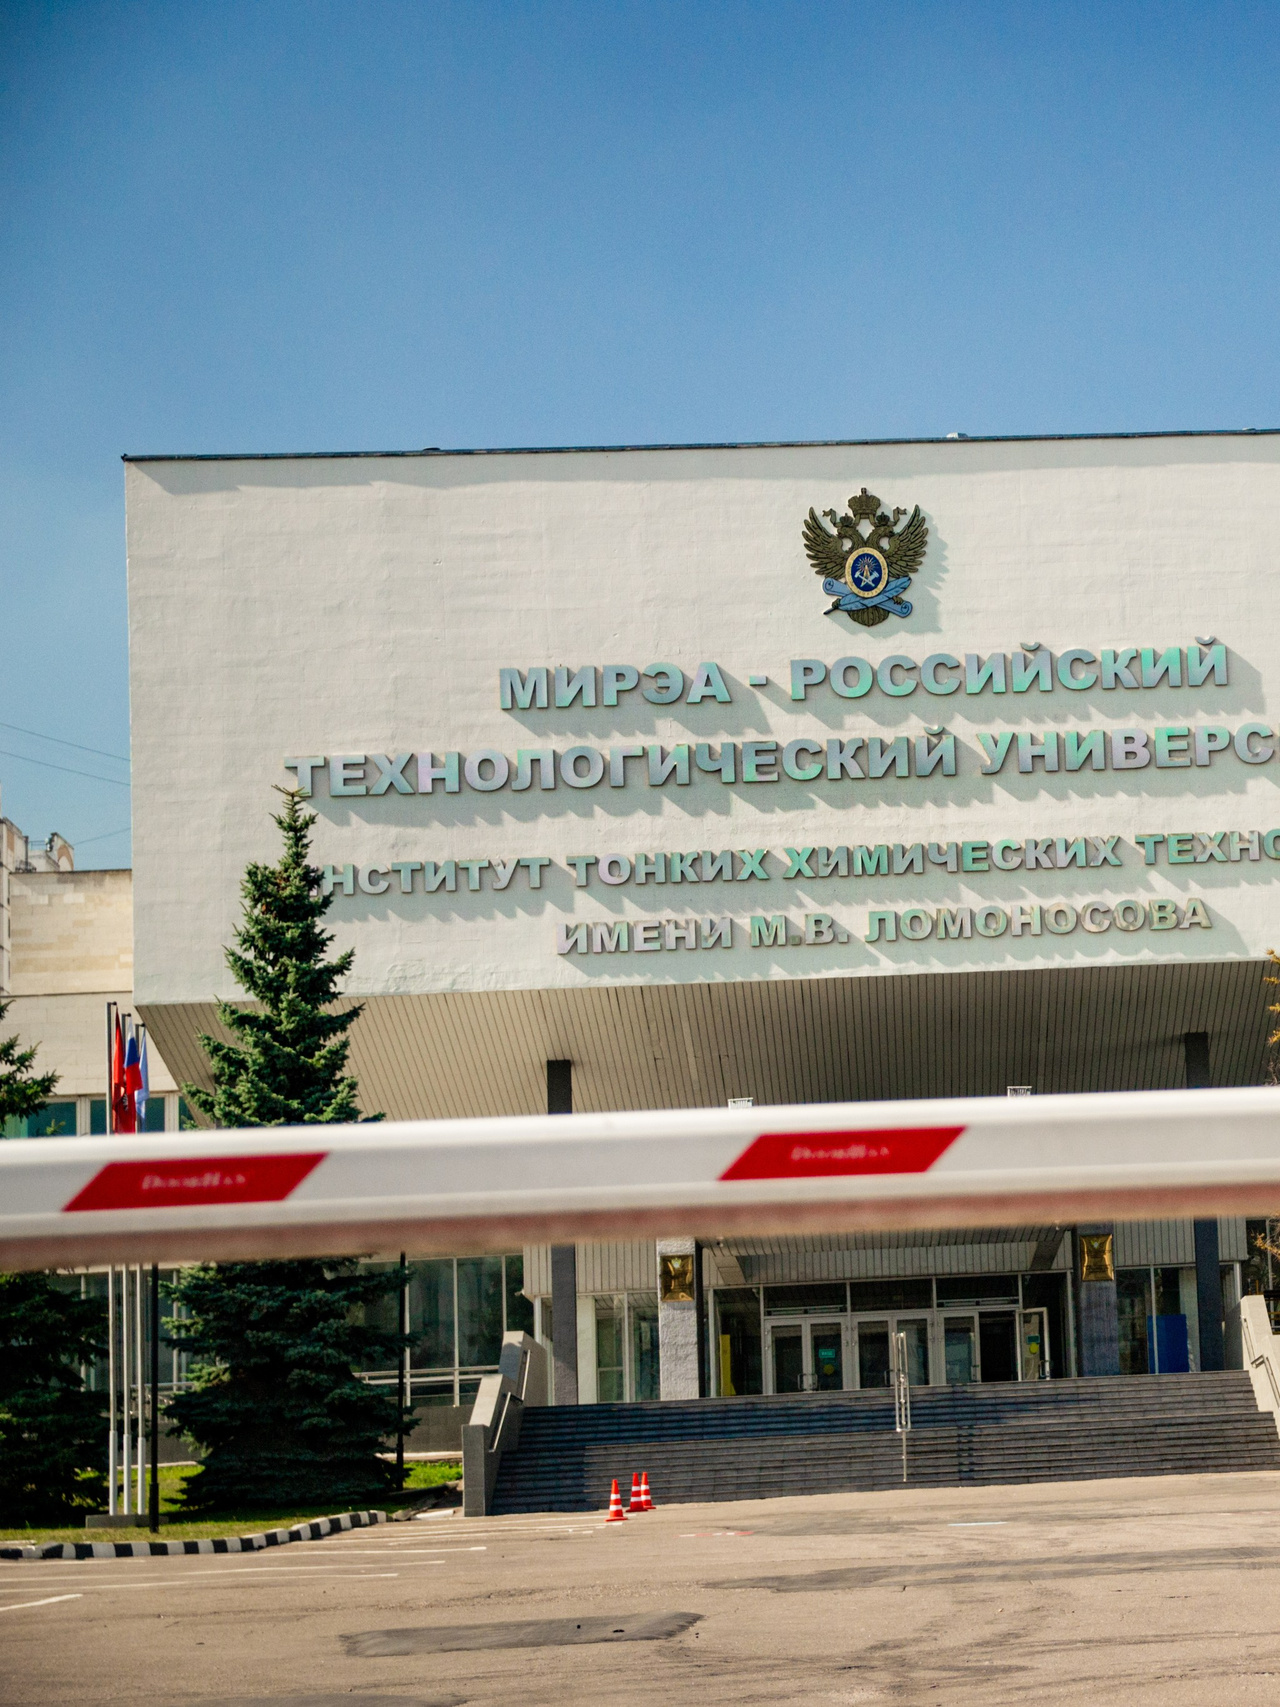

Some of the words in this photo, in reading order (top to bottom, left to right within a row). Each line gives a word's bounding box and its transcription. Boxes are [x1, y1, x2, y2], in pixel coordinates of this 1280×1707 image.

[499, 661, 731, 710] МИРЭА
[790, 636, 1228, 700] РОССИЙСКИЙ
[284, 724, 958, 798] ТЕХНОЛОГИЧЕСКИЙ
[307, 856, 550, 896] НСТИТУТ
[567, 848, 771, 887] ТОНКИХ
[783, 835, 1122, 879] ХИМИЧЕСКИХ
[556, 917, 732, 956] ИМЕНИ
[749, 912, 849, 948] М.В.
[864, 897, 1212, 943] ЛОМОНОСОВА
